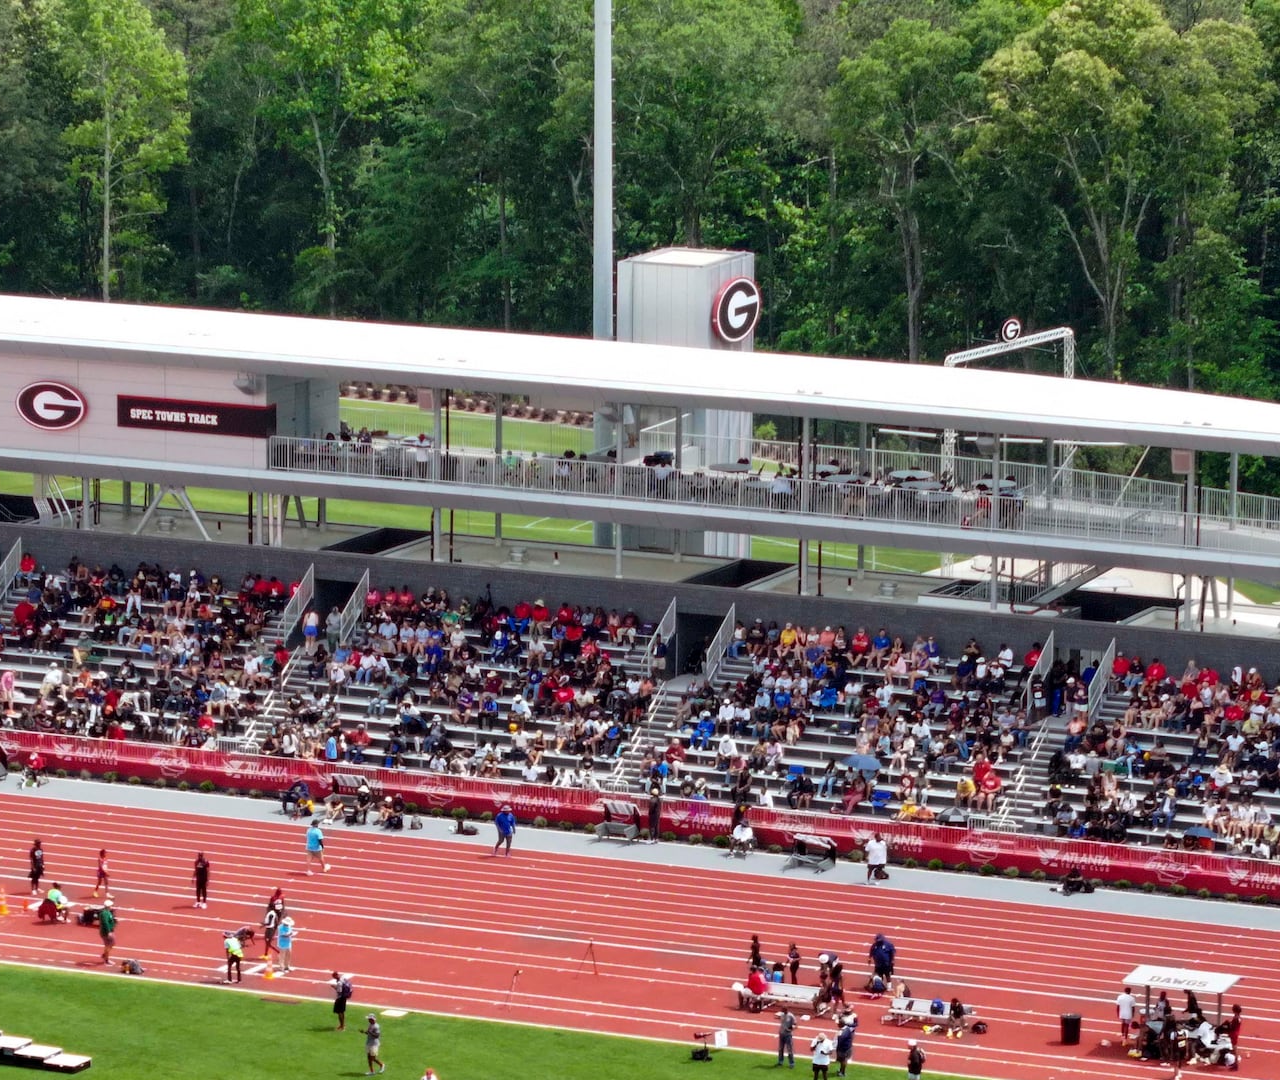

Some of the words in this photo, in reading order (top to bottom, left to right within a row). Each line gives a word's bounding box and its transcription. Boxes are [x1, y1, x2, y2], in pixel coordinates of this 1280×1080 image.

[130, 408, 153, 420] SPEC
[187, 412, 218, 425] TRACK
[77, 747, 118, 759] ATLANTA
[246, 763, 288, 777] ATLANTA
[515, 796, 560, 808] ATLANTA
[695, 813, 732, 827] ATLANT
[1063, 853, 1110, 866] ATLANTA
[1148, 975, 1209, 987] DAWGS
